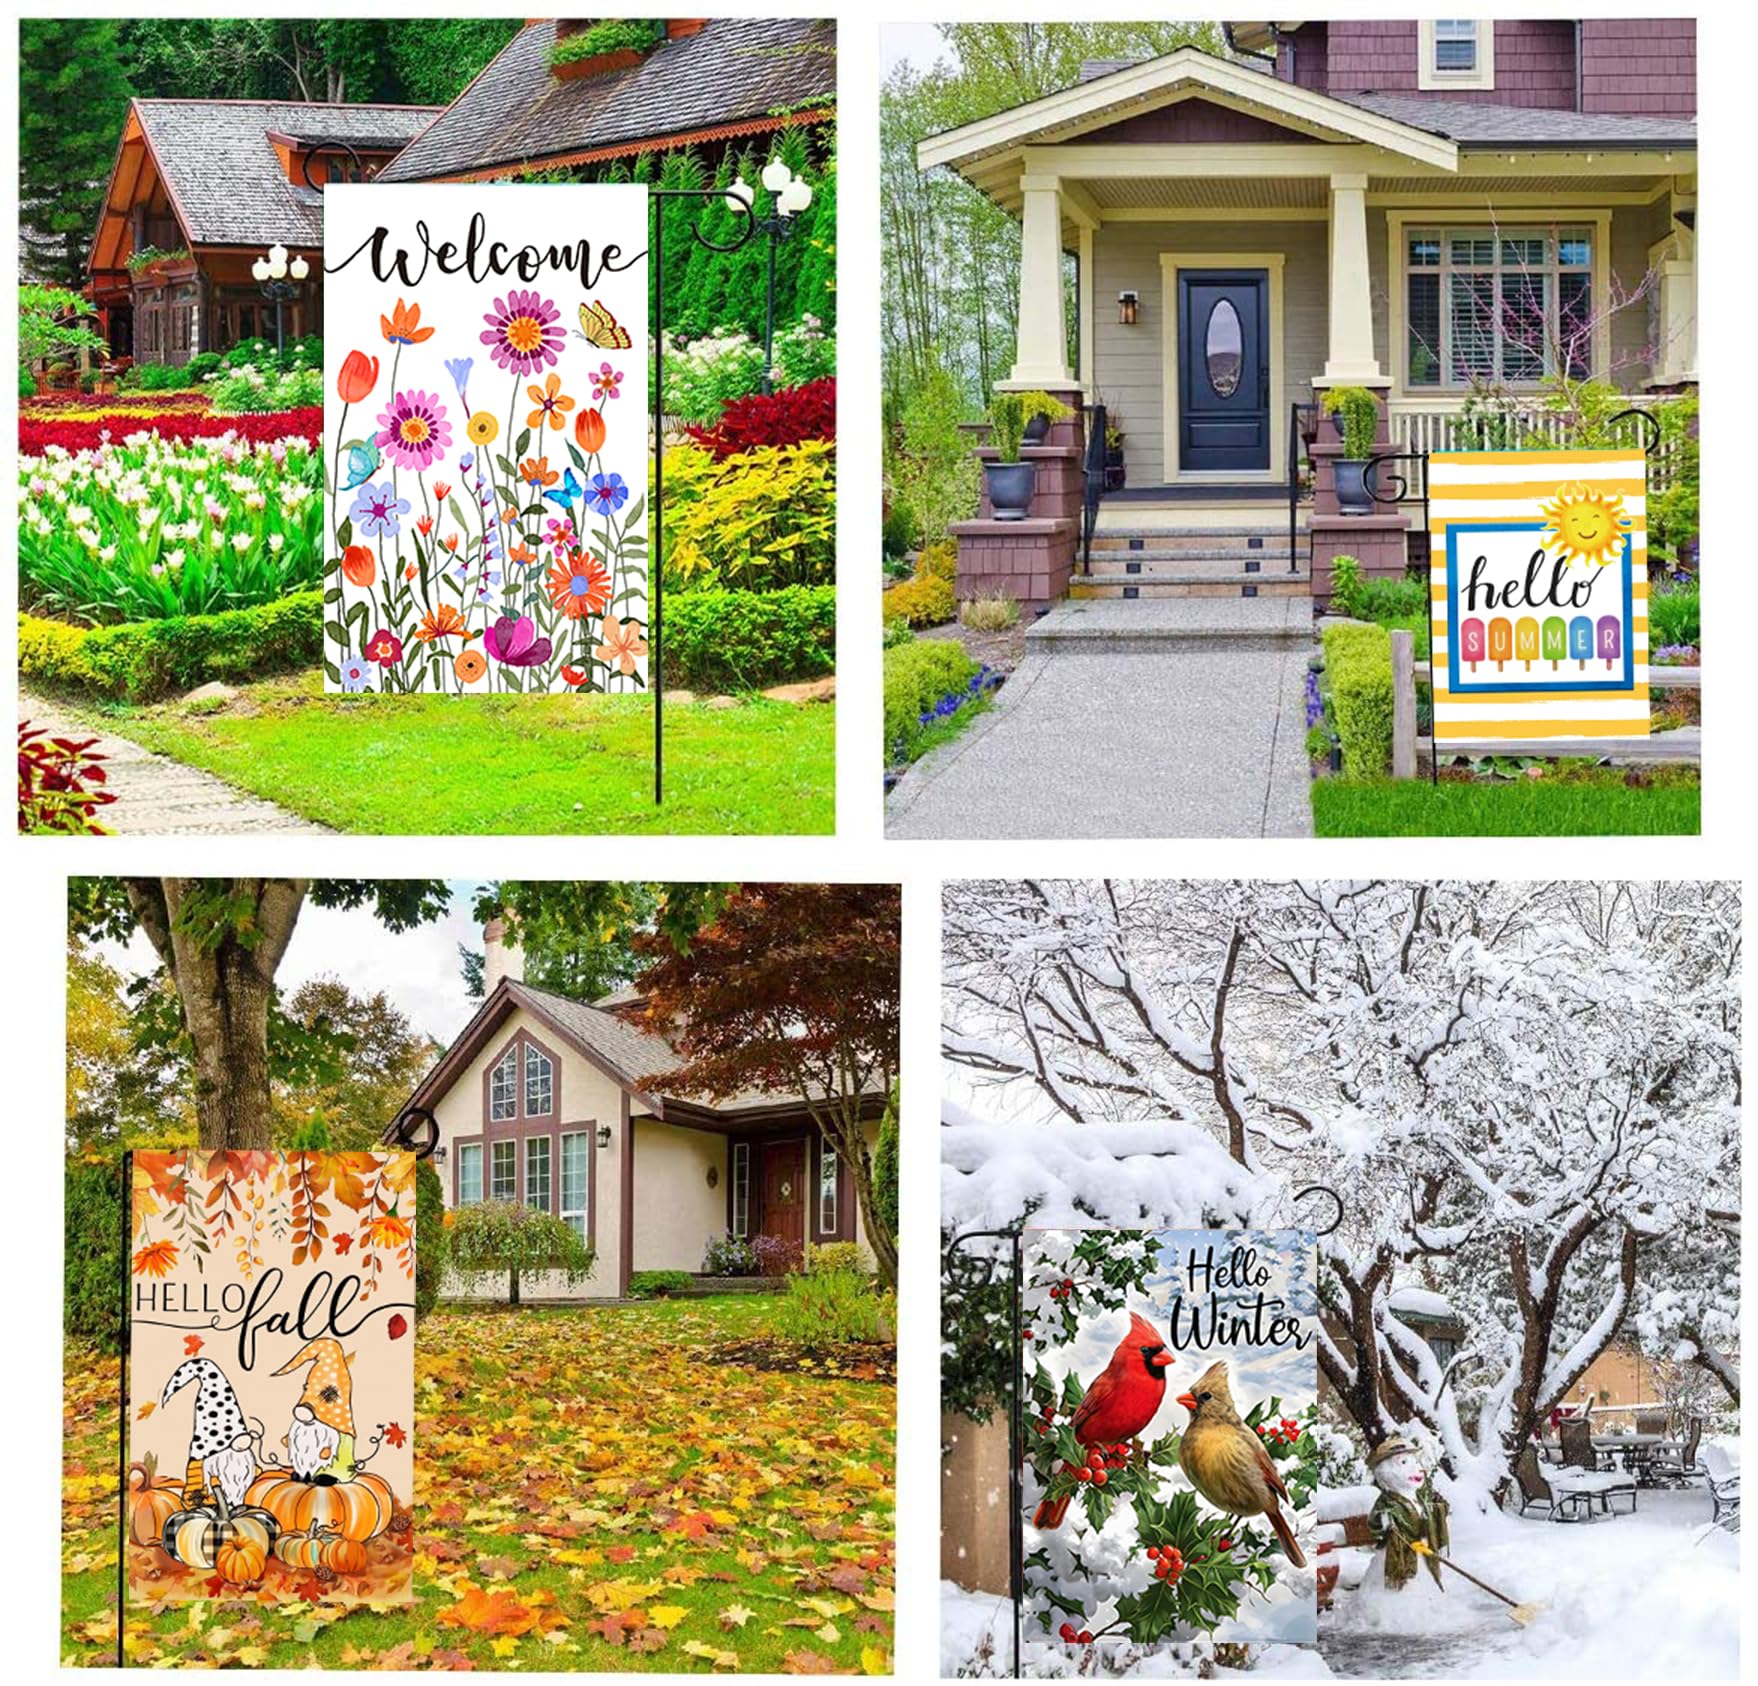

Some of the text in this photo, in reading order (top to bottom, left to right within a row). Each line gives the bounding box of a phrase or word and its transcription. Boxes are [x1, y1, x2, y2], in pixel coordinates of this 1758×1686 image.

[324, 212, 649, 290] Welcome
[1461, 549, 1604, 611] hello
[1467, 629, 1615, 652] SUMMER
[1185, 1245, 1272, 1293] Hello
[135, 1268, 415, 1372] HELLO fall
[1170, 1291, 1312, 1351] Winter
